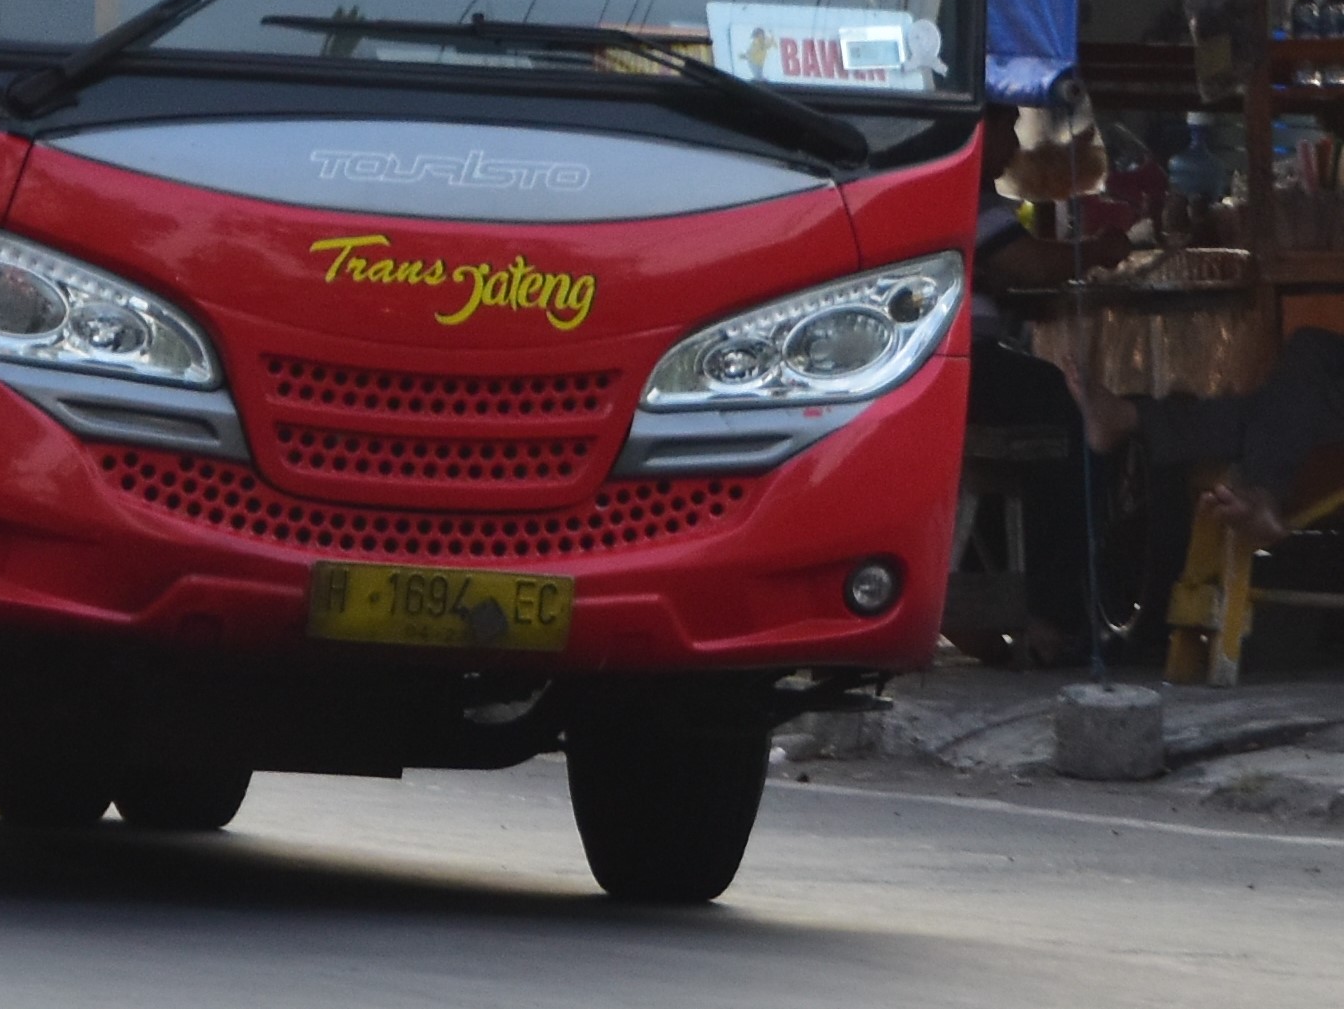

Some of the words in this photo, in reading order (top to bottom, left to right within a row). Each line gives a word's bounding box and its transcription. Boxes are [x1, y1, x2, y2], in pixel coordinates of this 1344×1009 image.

[310, 234, 447, 284] Trans
[434, 255, 596, 330] Jateng
[328, 569, 348, 613] H
[514, 580, 559, 625] EC
